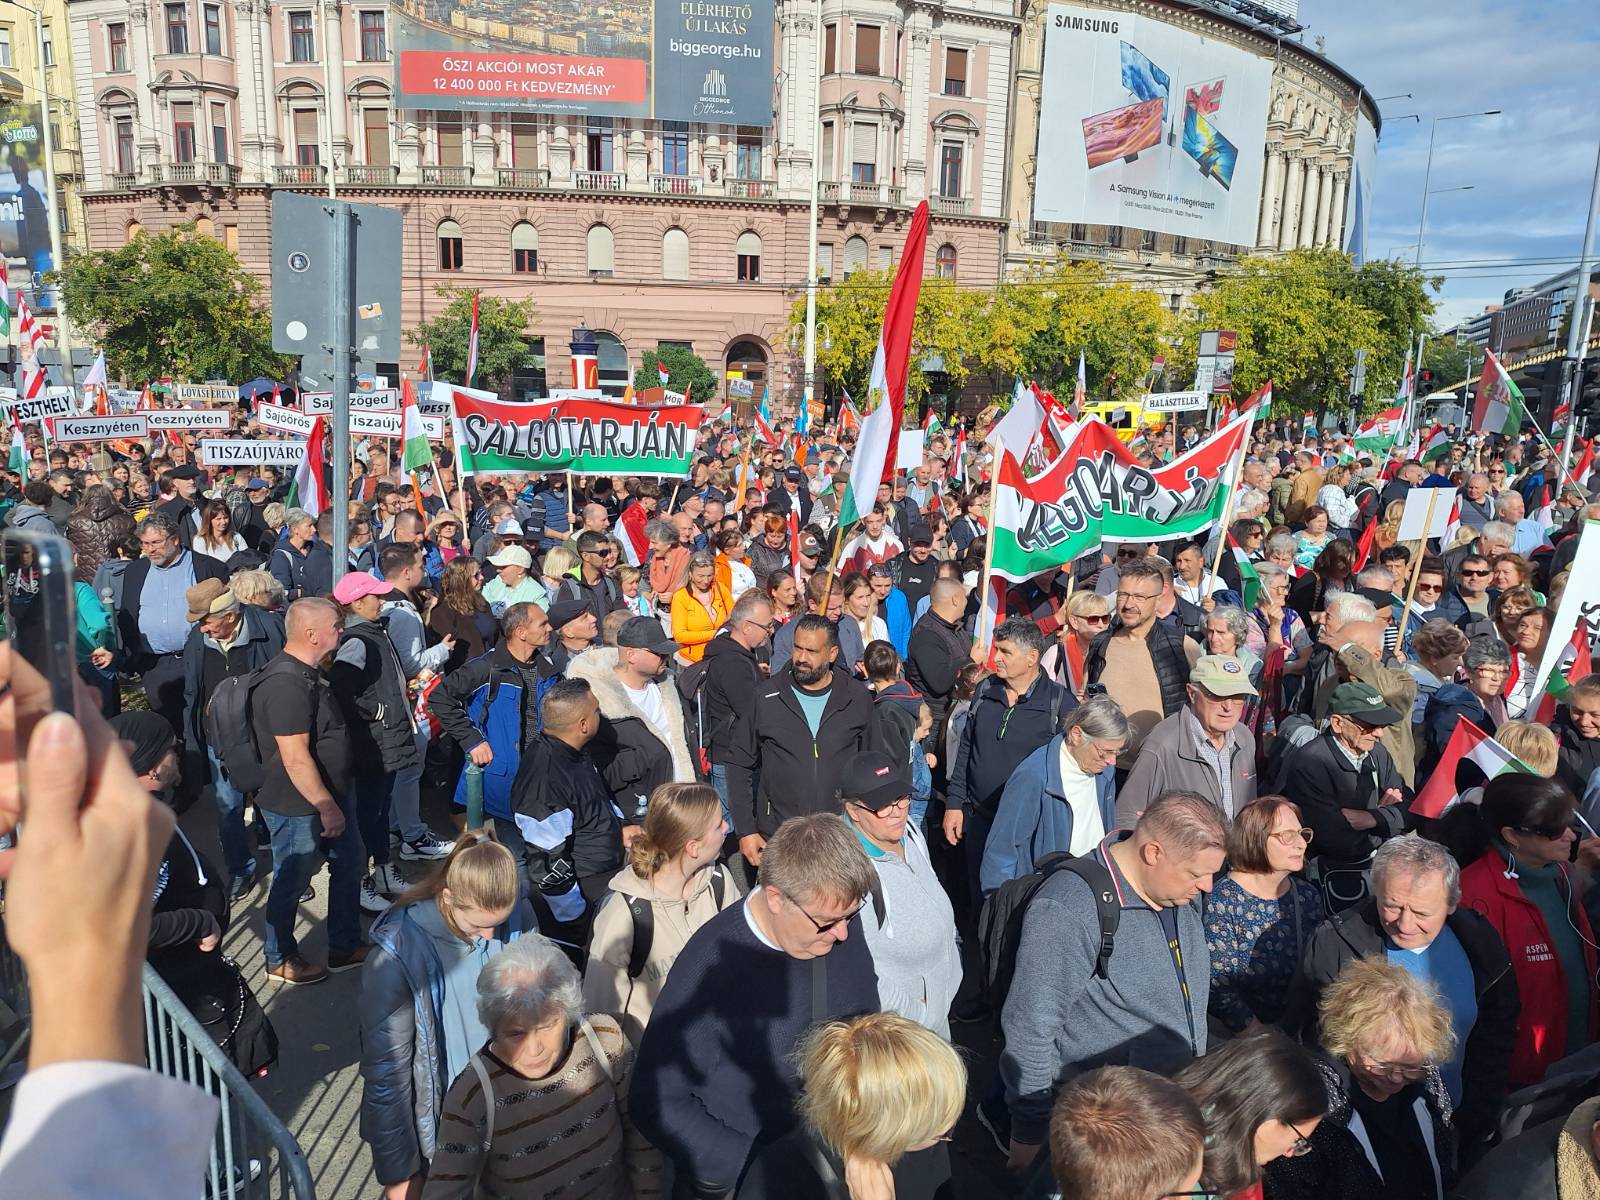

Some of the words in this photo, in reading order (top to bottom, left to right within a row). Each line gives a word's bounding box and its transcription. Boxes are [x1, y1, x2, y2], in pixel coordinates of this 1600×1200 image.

[680, 1, 752, 20] ELÉRHETŐ
[686, 17, 701, 32] ÚJ
[704, 19, 748, 35] LAKÁS
[1055, 14, 1119, 34] SAMSUNG
[670, 38, 761, 59] biggeorge.hu
[442, 58, 473, 73] ŐSZI
[476, 59, 522, 75] AKCIÓ!
[525, 62, 565, 76] MOST
[568, 62, 605, 78] AKÁR
[432, 78, 448, 89] 12
[450, 79, 475, 91] 400
[478, 79, 502, 92] 000
[506, 80, 519, 93] Ft
[1109, 183, 1116, 192] A
[1117, 184, 1148, 199] Samsung
[1149, 188, 1166, 200] Vision
[1166, 194, 1173, 202] AI
[6, 396, 71, 422] KESZTHELY
[1149, 396, 1200, 408] HALÁSZTELEK
[147, 414, 222, 426] Kesznyéten
[265, 408, 310, 429] Sajóörös
[64, 421, 140, 436] Kesznyéten
[464, 407, 689, 460] SALGÓTARJÁN
[208, 443, 304, 461] TISZAÚJVÁRO
[1525, 943, 1549, 954] ASPEN
